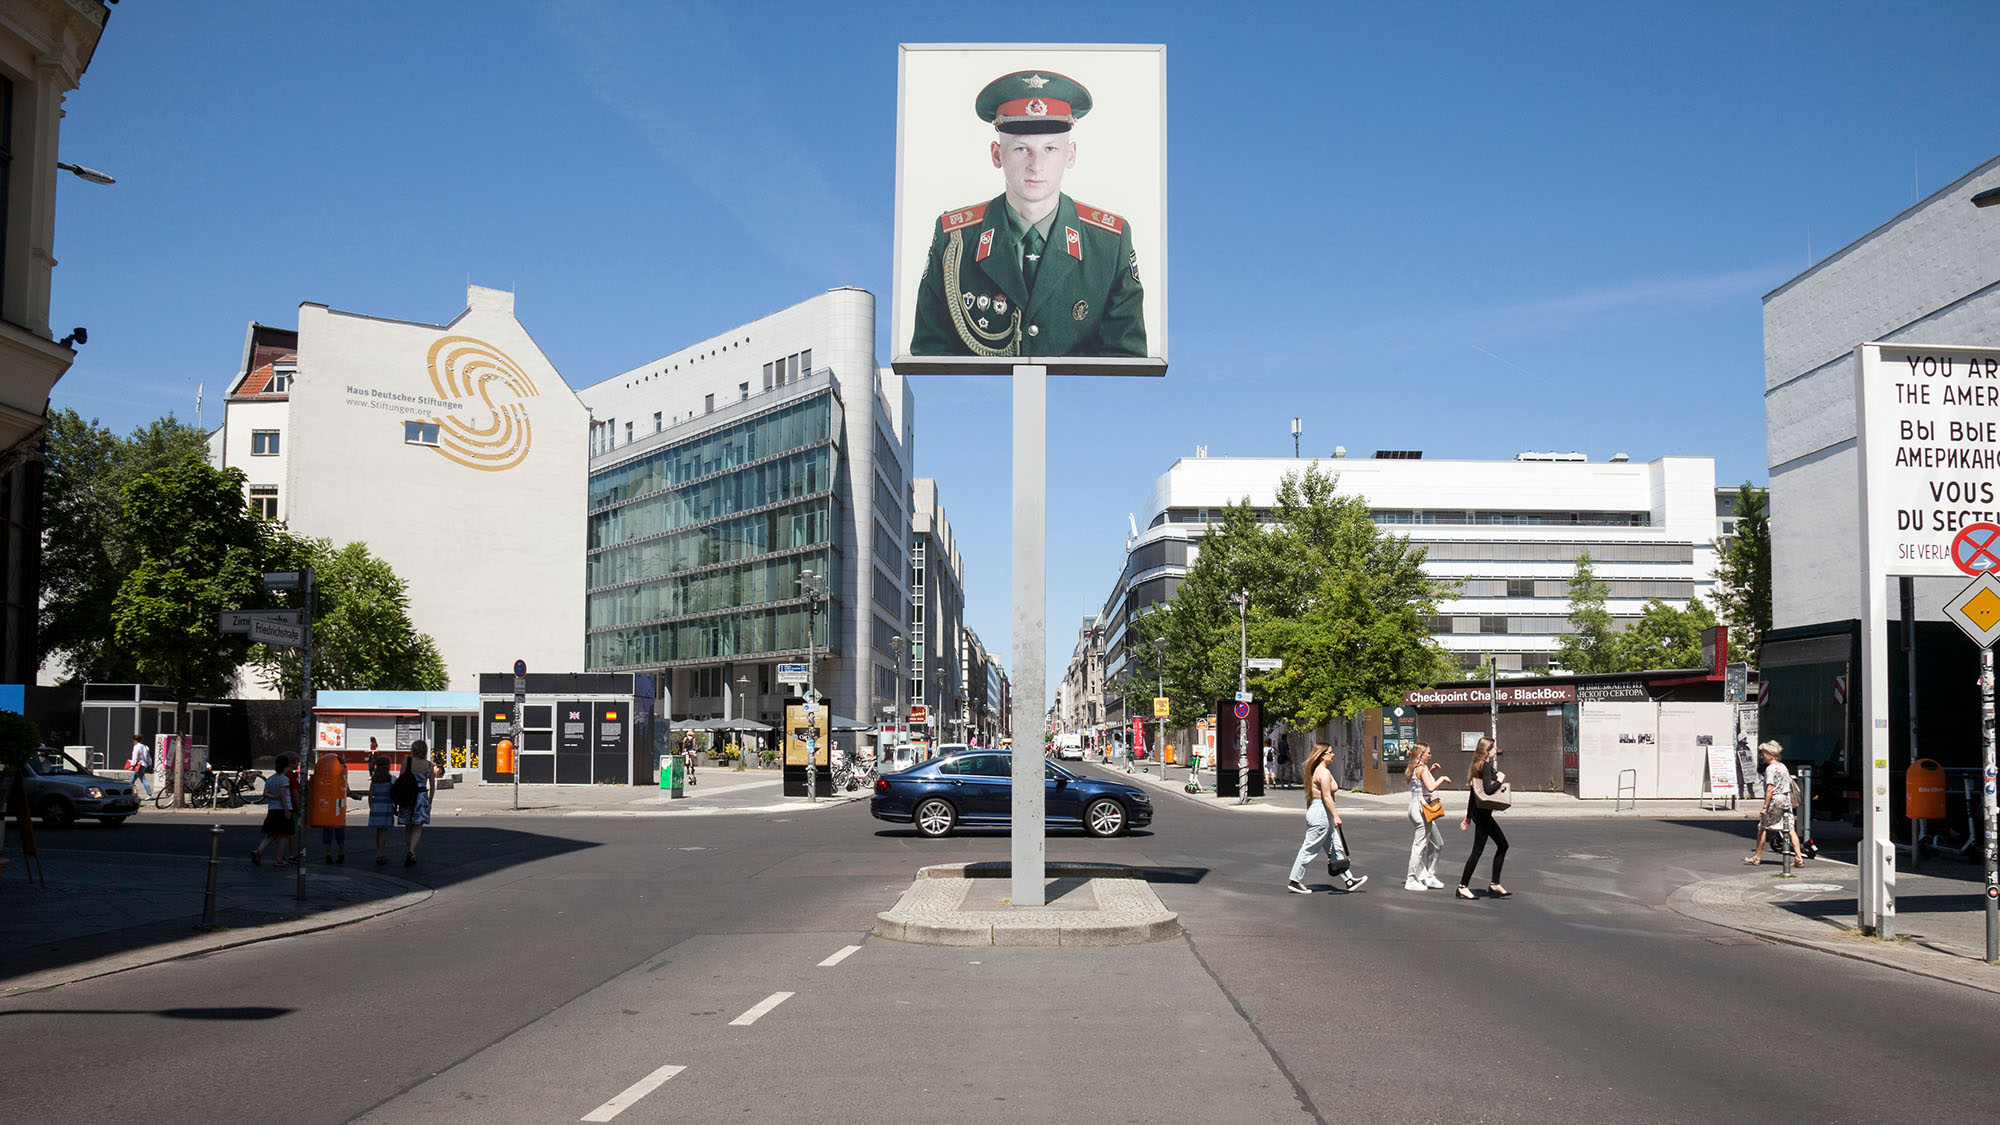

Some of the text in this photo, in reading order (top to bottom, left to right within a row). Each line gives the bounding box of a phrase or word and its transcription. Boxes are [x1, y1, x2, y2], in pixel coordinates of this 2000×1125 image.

[1906, 355, 1998, 379] YOU AR
[346, 385, 463, 410] Haus Deutscher Stiftungen
[1895, 383, 1999, 407] THE AMER
[346, 399, 431, 417] www.Stiftungen.org
[1900, 419, 1996, 443] ВЫ ВЫЕ
[1895, 446, 2000, 470] АМЕРИКАН
[1929, 480, 1994, 504] VOUS
[1897, 509, 1923, 531] DU
[1898, 543, 1915, 559] SIE
[255, 622, 299, 641] Friedrichstraße
[1410, 691, 1468, 704] Checkpoint
[1470, 689, 1508, 701] Chalie
[1514, 688, 1565, 700] BlackBox
[1609, 688, 1644, 697] СЕКТОРА
